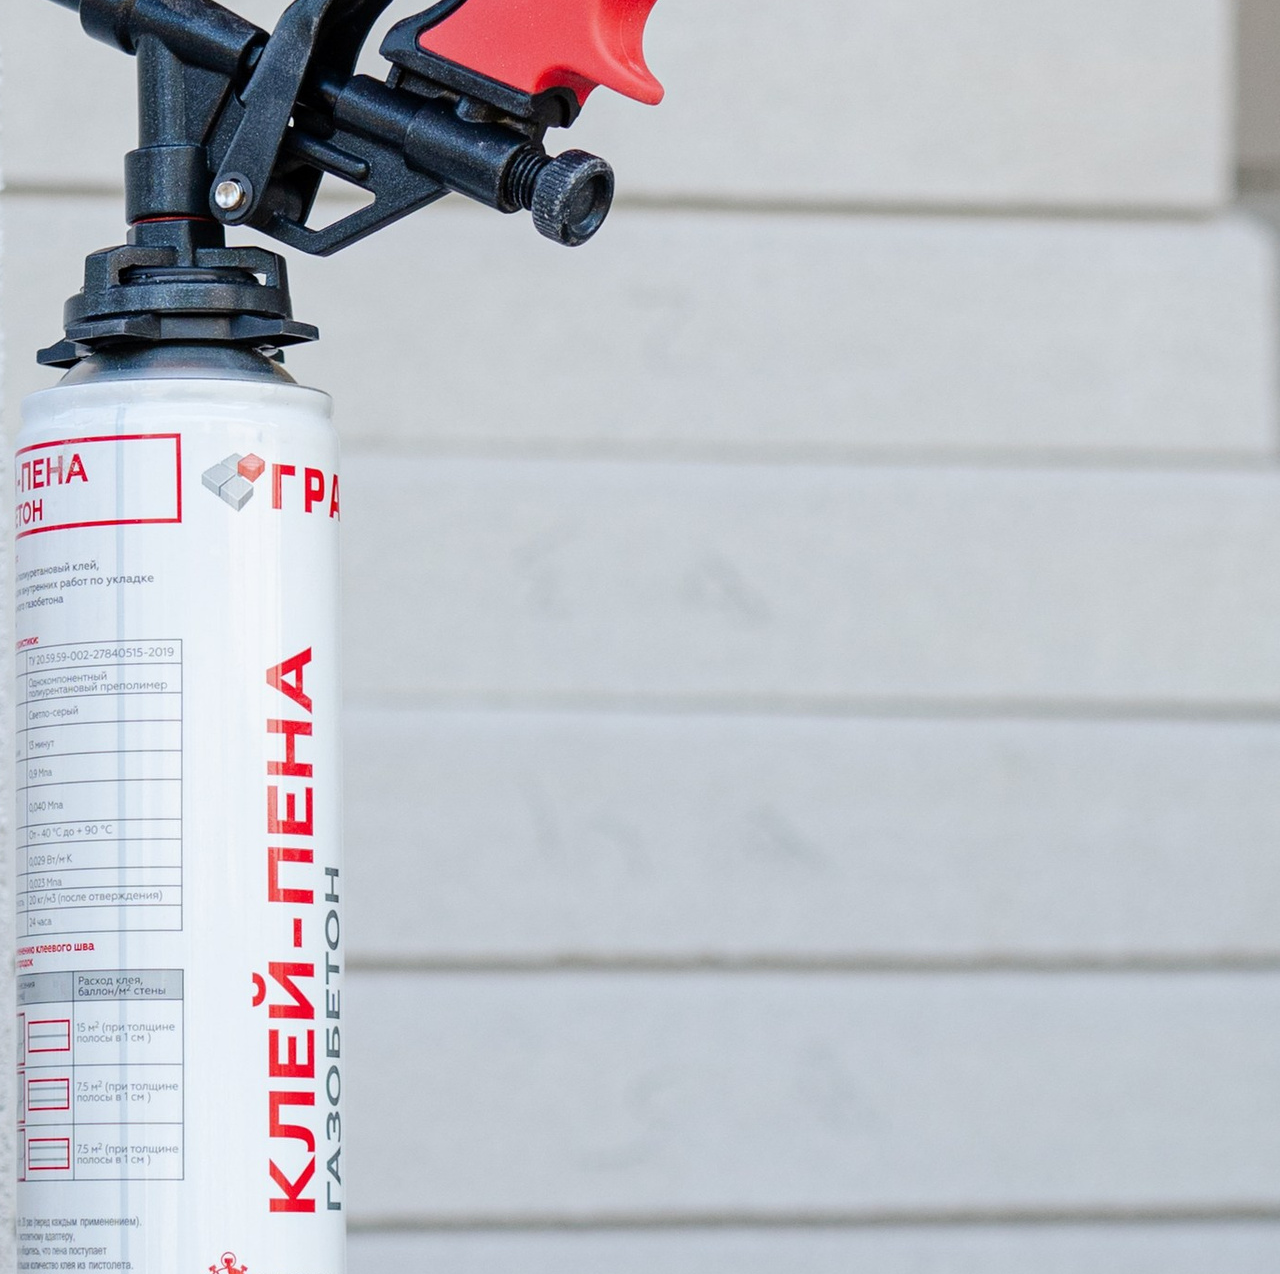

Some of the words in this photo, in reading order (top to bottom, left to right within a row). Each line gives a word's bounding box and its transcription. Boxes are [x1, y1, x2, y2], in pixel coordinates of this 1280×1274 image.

[16, 453, 89, 494] -ПЕНА
[271, 463, 341, 523] ГРА
[72, 559, 100, 573] клей,
[59, 575, 88, 592] работ
[90, 576, 104, 586] по
[106, 573, 155, 588] укладке
[28, 670, 108, 689] Однокомпонентный
[100, 679, 169, 693] преполимер
[28, 705, 80, 722] Светло-серый
[47, 800, 64, 811] Мпа
[63, 828, 75, 838] до
[84, 824, 98, 835] 90
[57, 891, 87, 905] (после
[88, 889, 163, 903] отверждения)
[252, 645, 317, 1215] КЛЕЙ-ПЕНА
[35, 942, 72, 955] клеевого
[74, 941, 96, 953] шва
[78, 975, 114, 988] Расход
[115, 976, 144, 987] клея,
[133, 987, 166, 997] стены
[101, 1023, 126, 1034] (при
[127, 1024, 175, 1034] толщине
[76, 1034, 113, 1044] полосы
[324, 866, 343, 1212] ГАЗОБЕТОН
[104, 1082, 129, 1093] (при
[130, 1083, 178, 1093] толщине
[76, 1093, 113, 1103] полосы
[104, 1144, 129, 1155] (при
[130, 1145, 178, 1155] толщине
[76, 1155, 113, 1165] полосы
[80, 1216, 142, 1229] применением).
[69, 1246, 107, 1258] поступает
[89, 1261, 134, 1271] пистолета.
